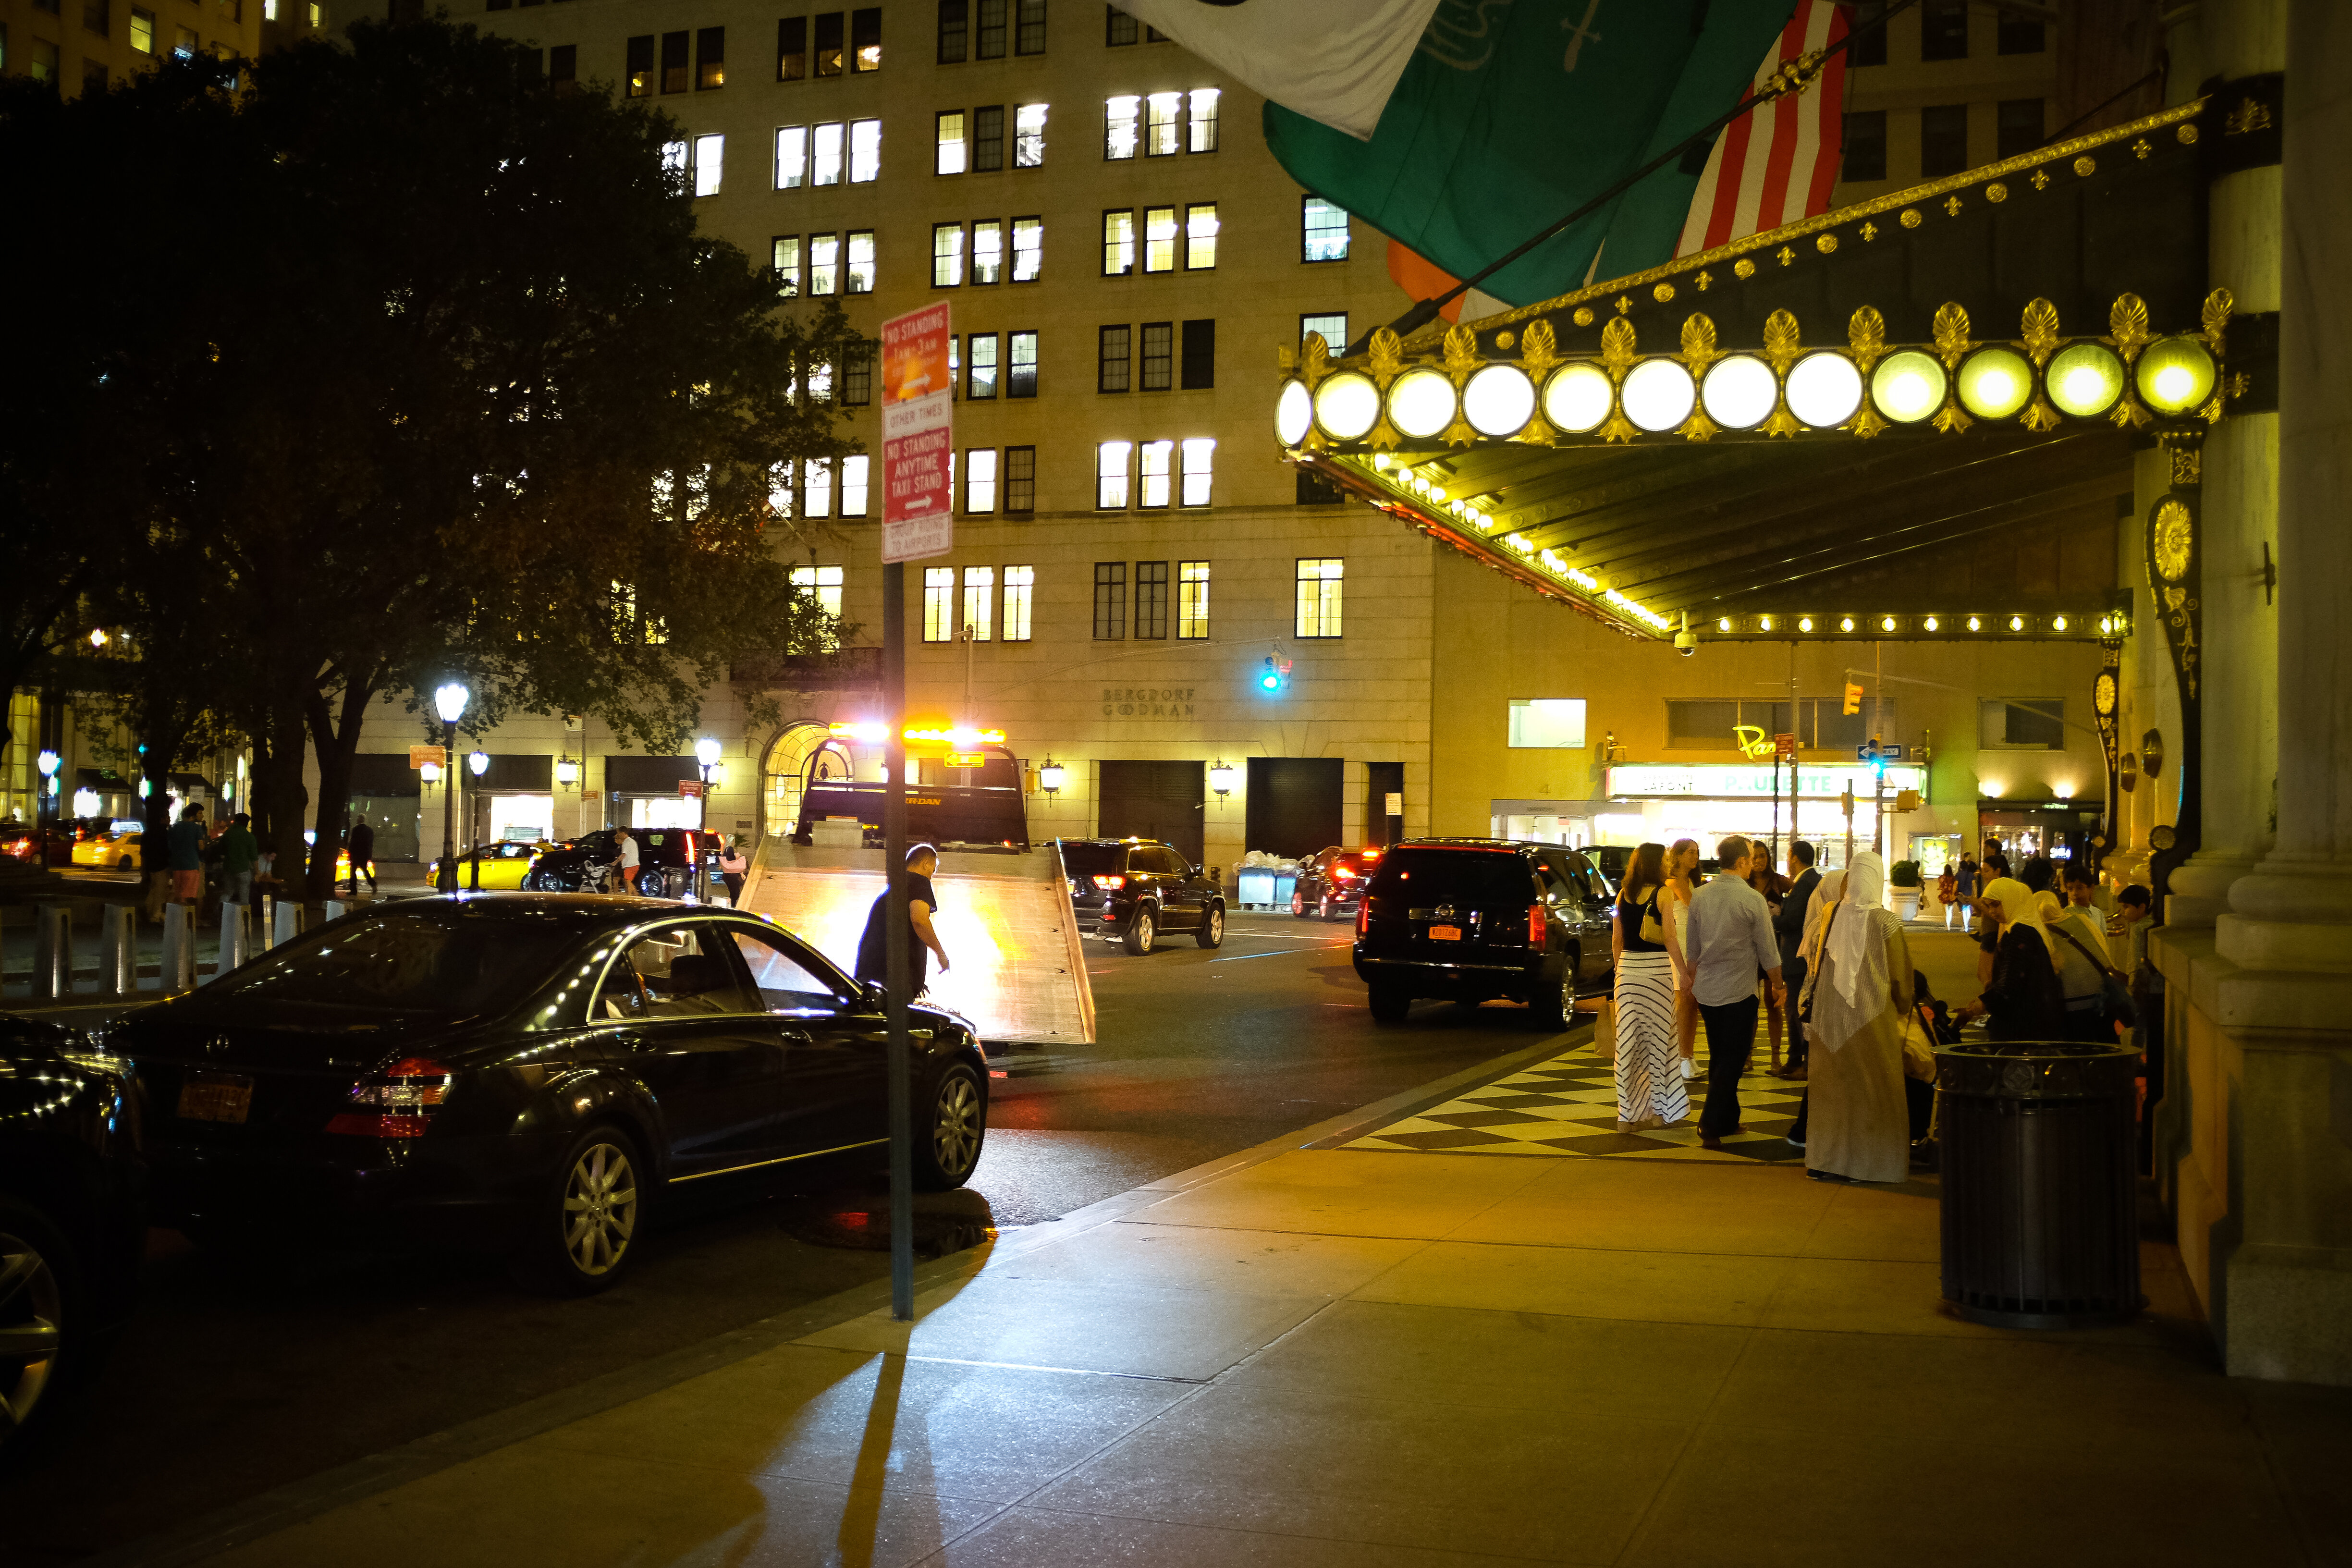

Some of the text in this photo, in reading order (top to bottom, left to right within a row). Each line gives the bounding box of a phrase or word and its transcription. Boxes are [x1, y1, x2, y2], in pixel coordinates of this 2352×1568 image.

[887, 311, 943, 344] NO STANDING
[890, 403, 942, 428] OTHER TIMES
[888, 431, 945, 460] NO STANDING
[895, 453, 938, 478] ANYTIME
[892, 471, 942, 498] TAXI STAND
[1103, 689, 1195, 700] BERGDORF
[1725, 776, 1831, 792] PAULETTE
